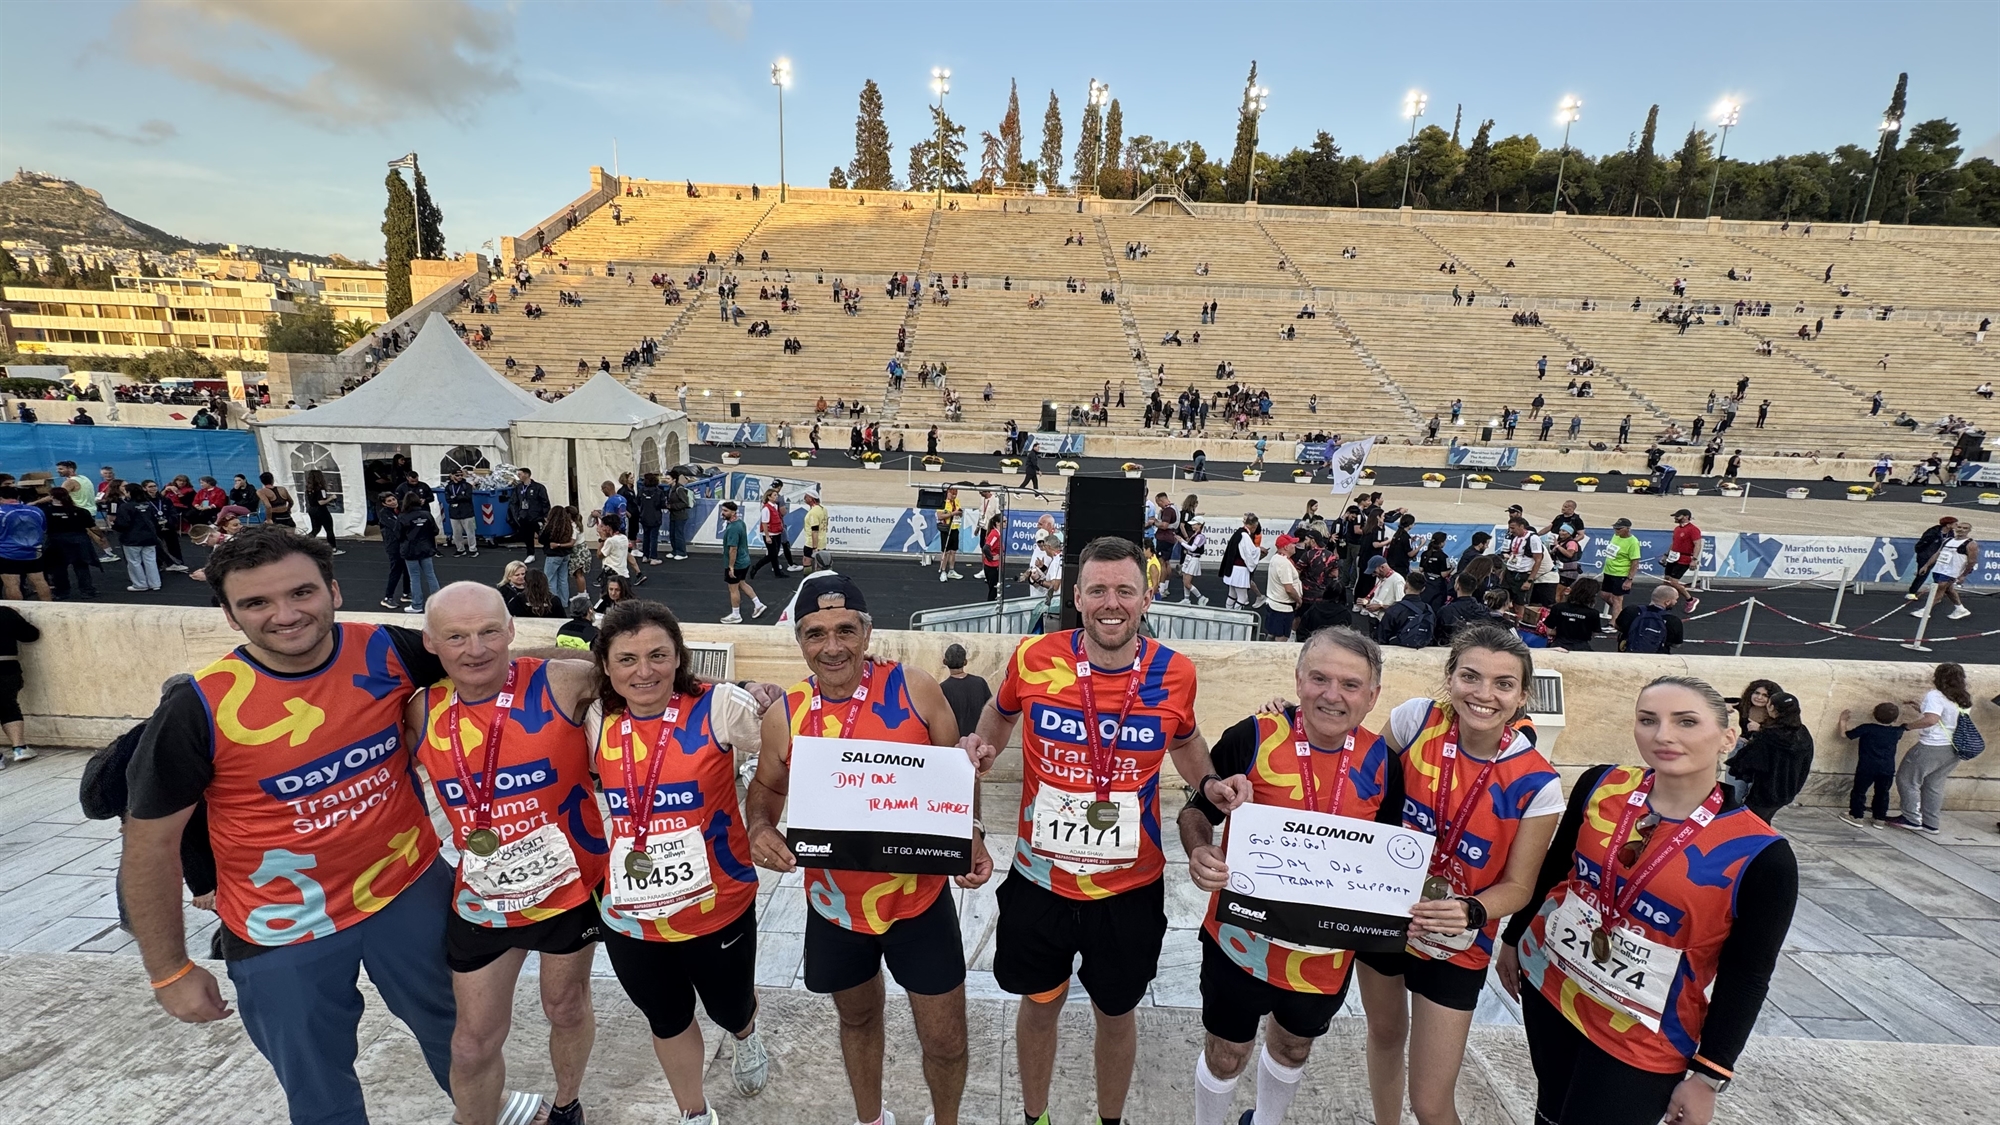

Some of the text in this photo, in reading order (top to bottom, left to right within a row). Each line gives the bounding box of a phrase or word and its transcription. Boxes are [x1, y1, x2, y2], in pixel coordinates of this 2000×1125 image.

[827, 514, 853, 523] rathon
[866, 515, 895, 524] Athens
[831, 526, 871, 535] Authentic
[1262, 528, 1284, 536] thens
[1784, 544, 1867, 554] Marathon to Athens
[1784, 555, 1843, 565] The Authentic
[1784, 567, 1820, 575] 42.195km
[1041, 709, 1154, 743] Day One
[275, 736, 397, 794] Day One
[841, 751, 925, 768] SALOMON
[495, 769, 546, 790] One
[831, 771, 897, 788] DAY ONE
[287, 767, 391, 816] Trauma
[653, 790, 693, 807] One
[293, 779, 398, 834] Support
[454, 797, 539, 823] Truma
[866, 797, 969, 815] TRAUMA SUPPORT
[1403, 798, 1483, 860] Day ne
[1620, 810, 1632, 835] AUTHENTIC
[1283, 821, 1375, 845] SALOMON
[664, 850, 685, 859] allwyn
[795, 841, 833, 853] Gravel.
[882, 846, 963, 859] LET GO. ANYWHERE.
[1228, 902, 1267, 920] Gravel.
[1635, 897, 1671, 925] ne
[1318, 920, 1401, 937] LET GO. ANYWHERE.
[1621, 950, 1648, 965] allwyn
[1571, 957, 1630, 997] KAROLINA NOWICKA
